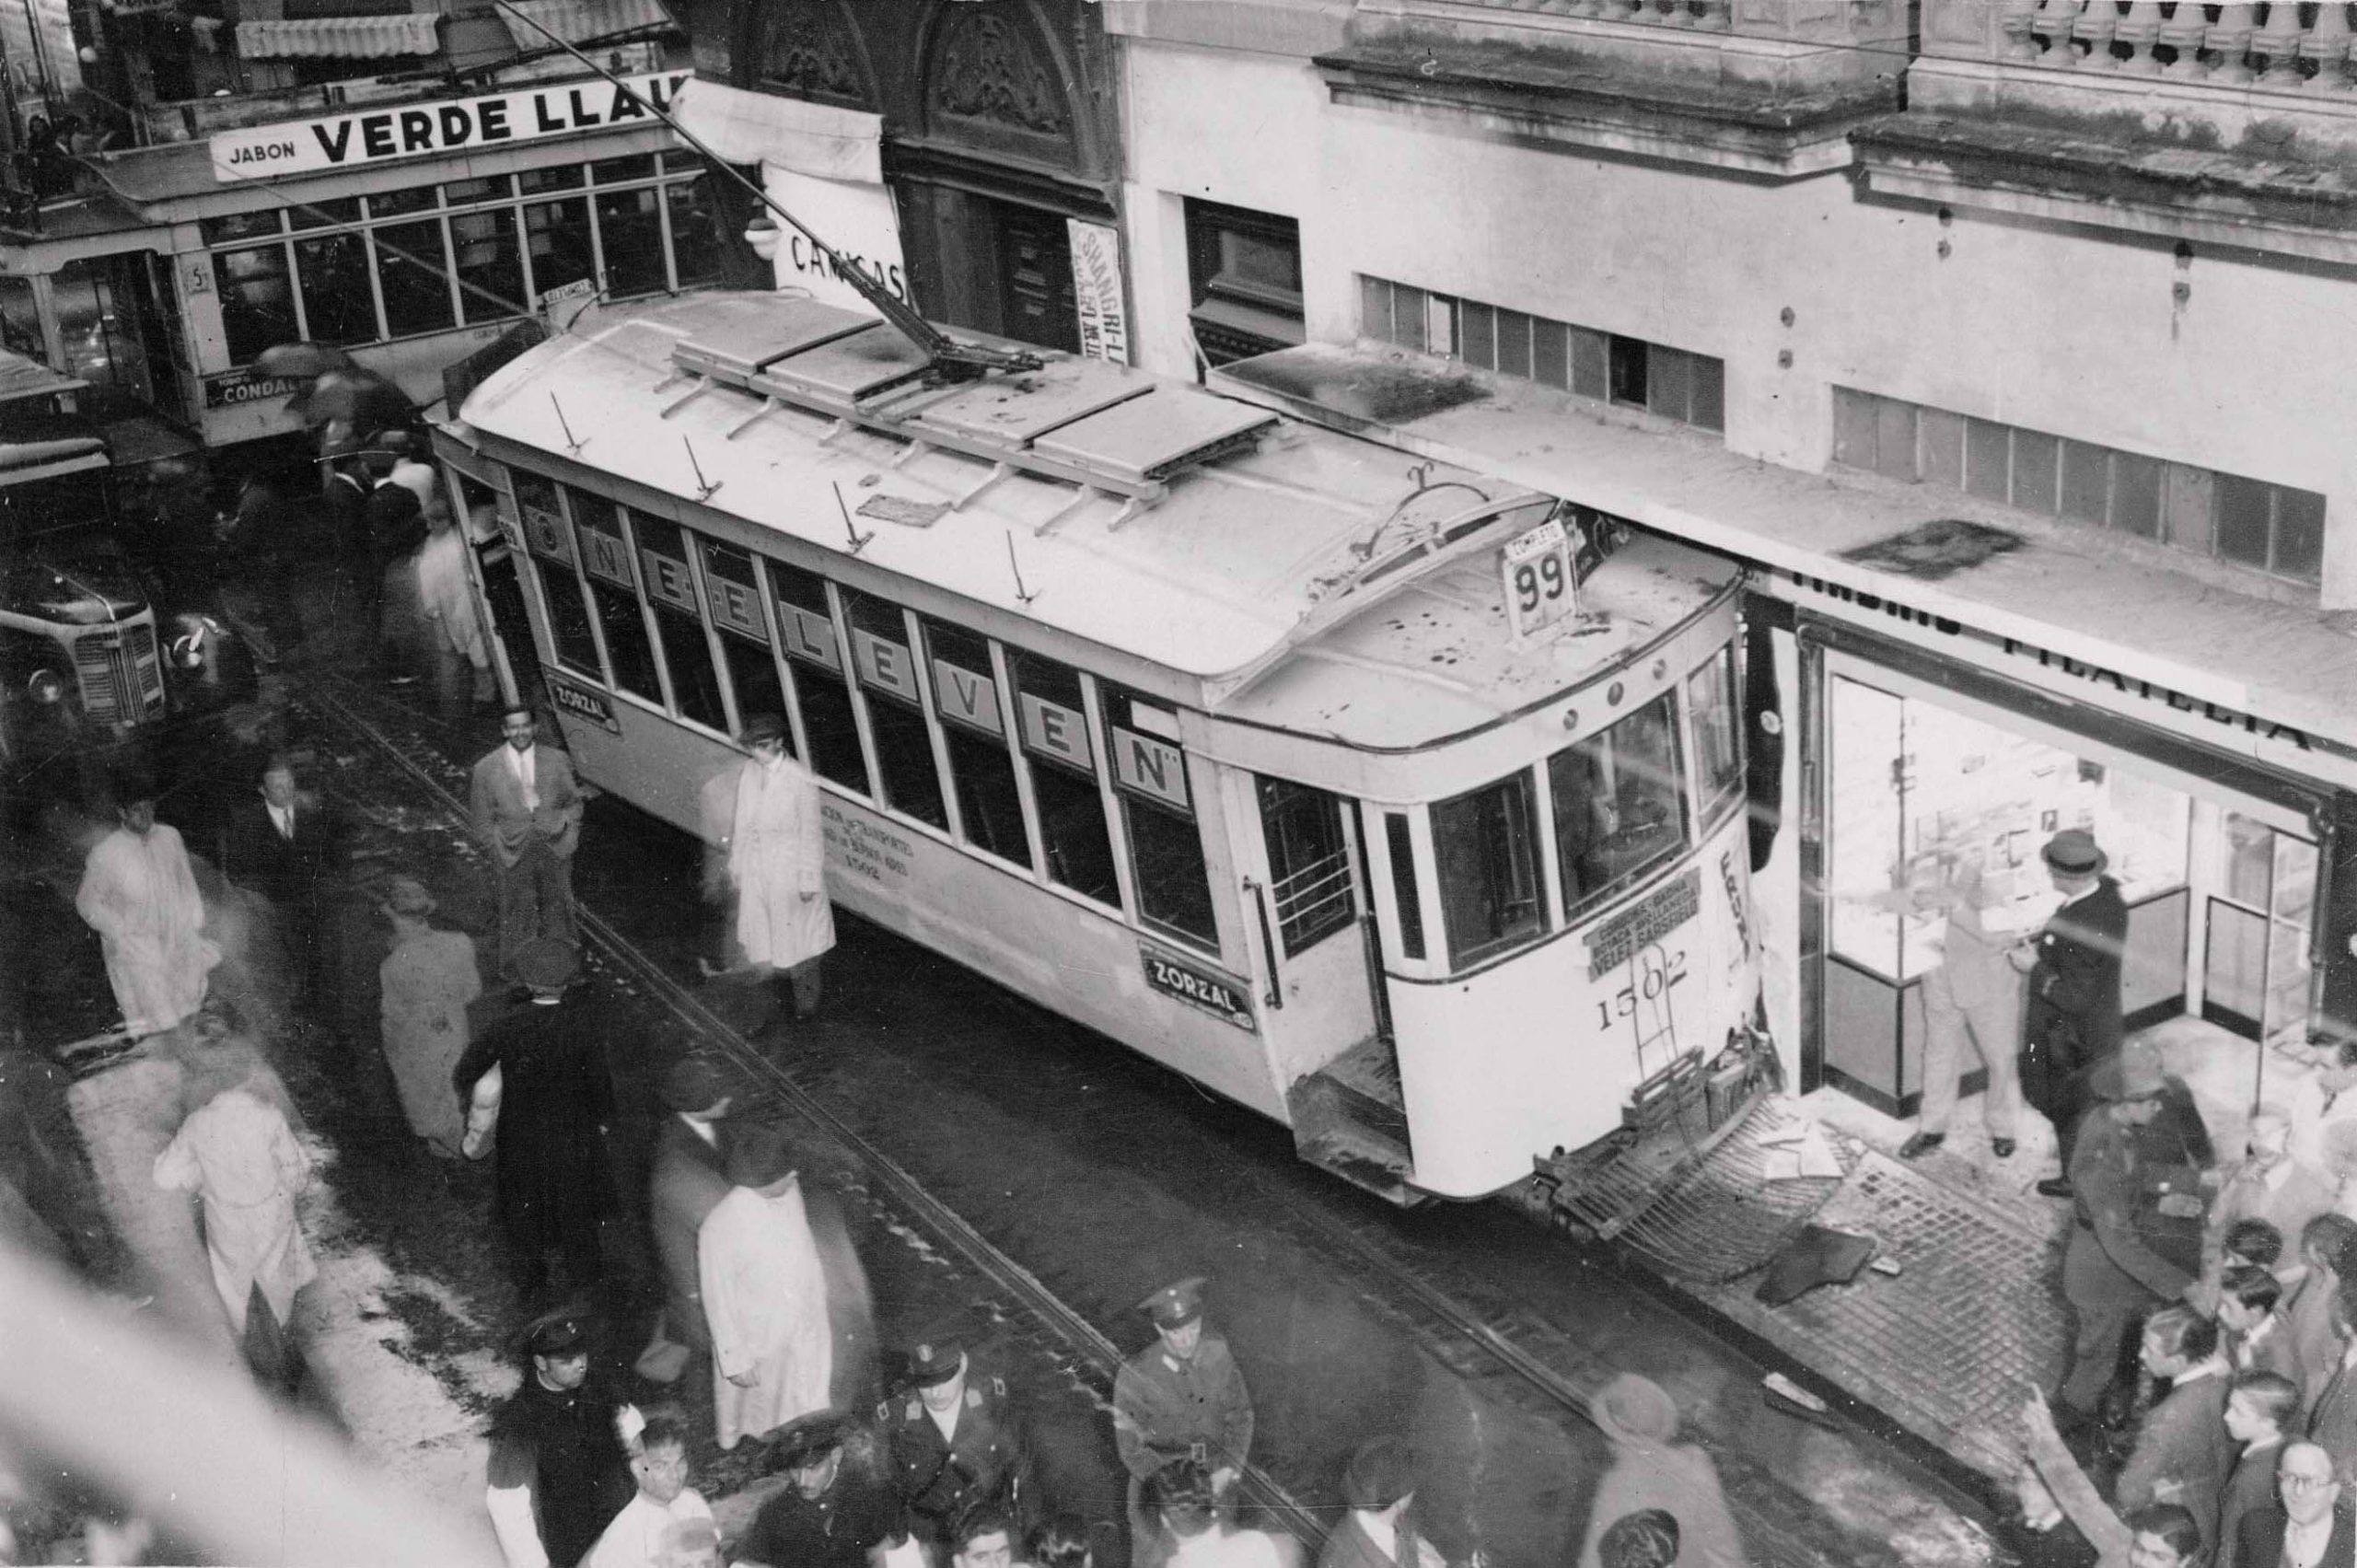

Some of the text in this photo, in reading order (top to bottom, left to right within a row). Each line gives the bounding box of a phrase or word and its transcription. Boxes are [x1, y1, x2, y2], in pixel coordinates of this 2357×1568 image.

[230, 141, 296, 165] JABON
[310, 99, 512, 164] VERDE
[791, 235, 905, 301] CAMAS
[1514, 552, 1564, 612] 99
[556, 686, 607, 719] ZORZAL
[1154, 960, 1237, 1012] ZORZAL
[1596, 949, 1688, 1032] 1502
